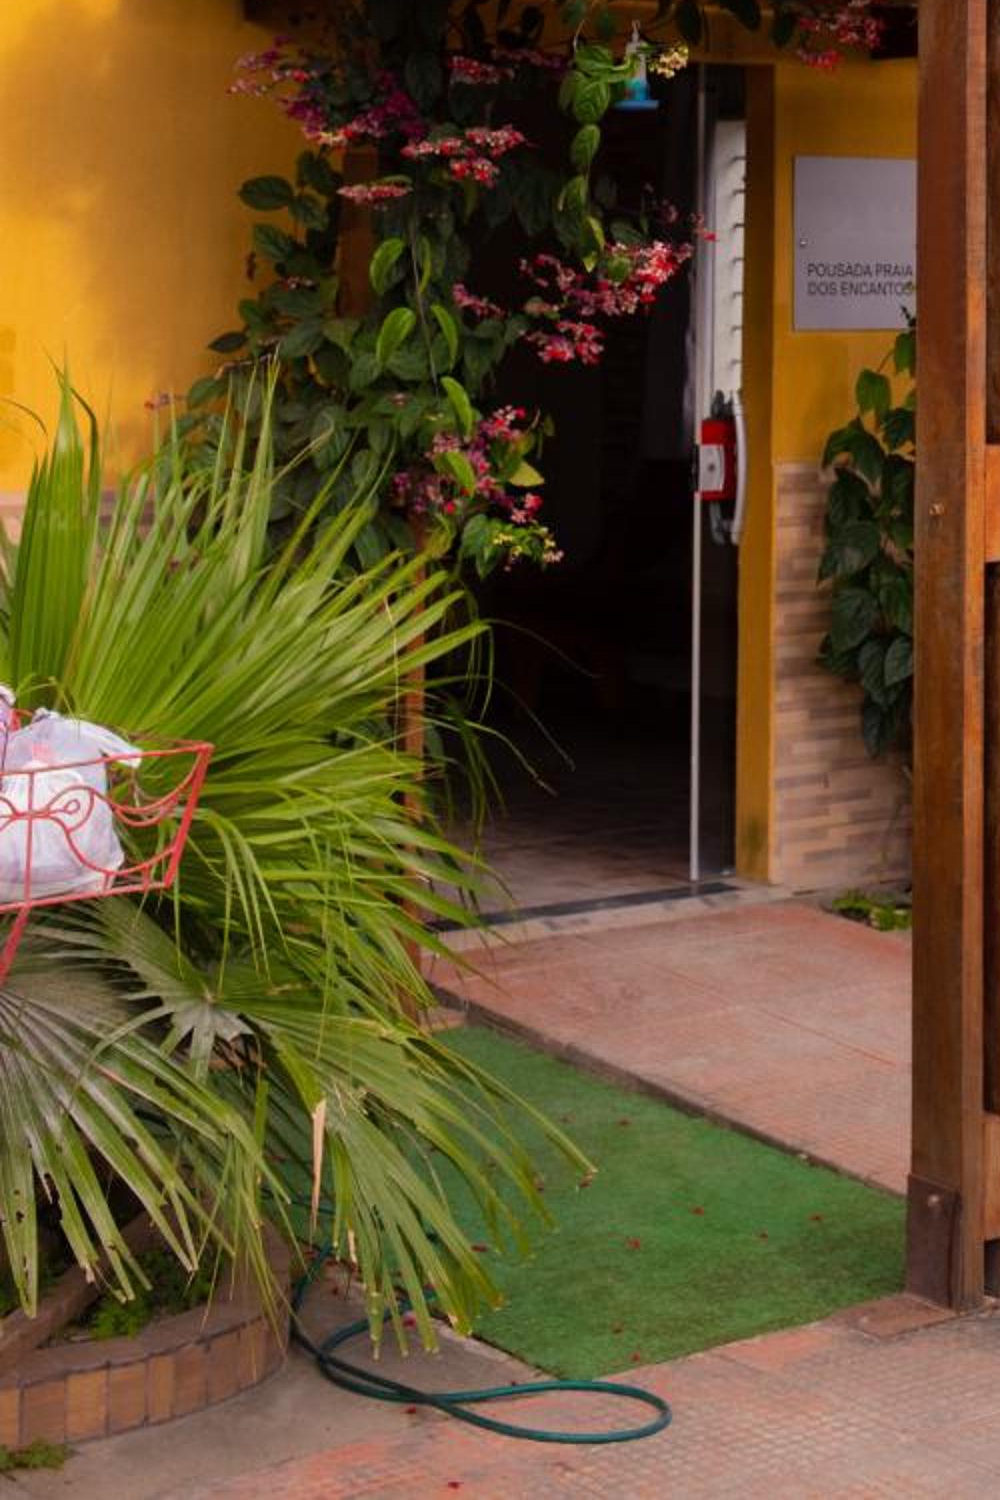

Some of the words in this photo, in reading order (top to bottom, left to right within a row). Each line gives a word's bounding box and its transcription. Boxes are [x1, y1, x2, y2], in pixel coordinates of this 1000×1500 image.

[807, 263, 873, 277] POUSADA
[875, 263, 913, 277] PRAIA
[807, 281, 838, 296] DOS
